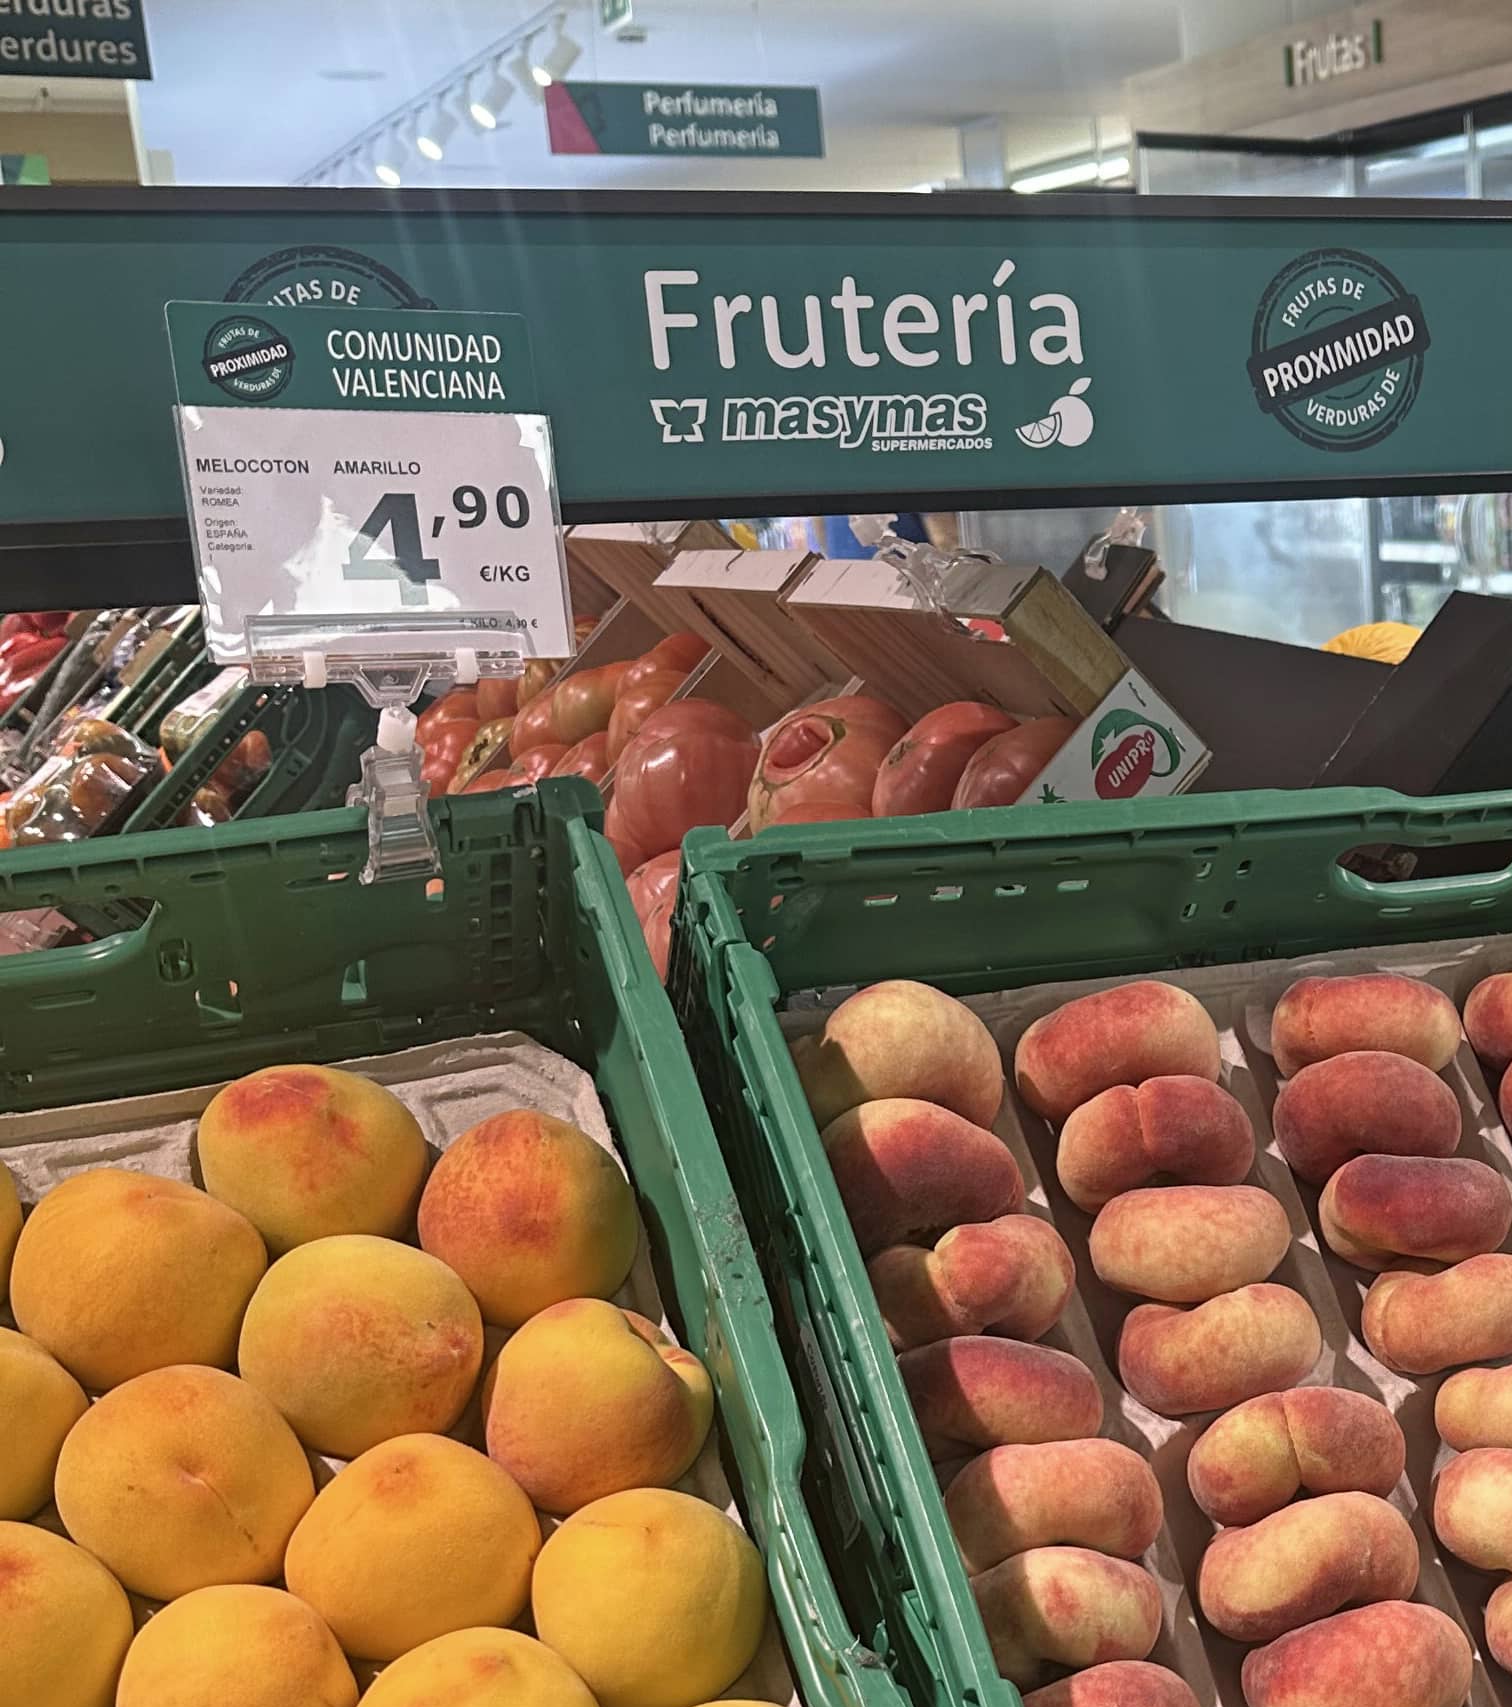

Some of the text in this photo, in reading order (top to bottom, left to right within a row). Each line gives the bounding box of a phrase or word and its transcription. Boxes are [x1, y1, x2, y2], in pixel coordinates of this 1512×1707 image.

[1293, 34, 1365, 85] Frutas
[331, 280, 361, 306] DE
[1281, 277, 1365, 328] FRUTAS DE
[644, 259, 1084, 370] Frutería
[210, 344, 288, 378] PROXIMIDAD
[326, 330, 502, 364] COMUNIDAD
[1263, 314, 1415, 397] PROXIMIDAD
[332, 367, 506, 400] VALENCIANA
[1306, 368, 1400, 426] VERDURAS DE
[722, 393, 988, 449] masymas
[871, 437, 993, 452] SUPERMERCADOS
[196, 458, 421, 475] MELOCOTON AMARILLO
[480, 565, 530, 583] €/KG
